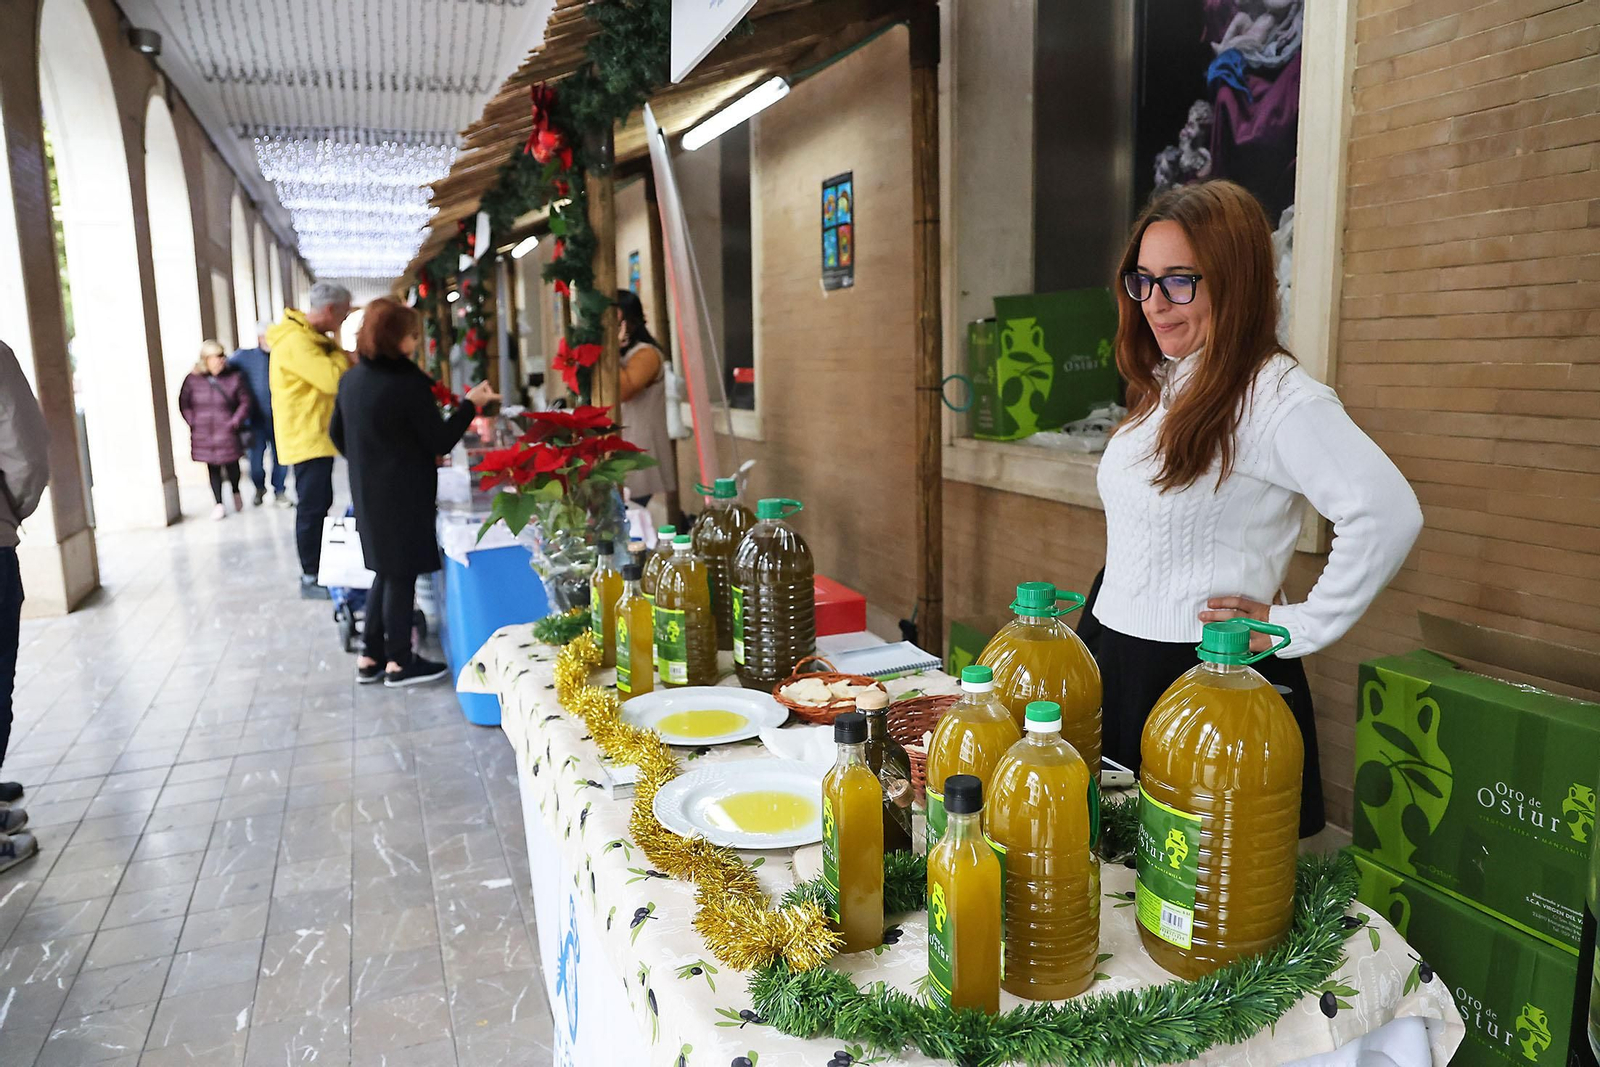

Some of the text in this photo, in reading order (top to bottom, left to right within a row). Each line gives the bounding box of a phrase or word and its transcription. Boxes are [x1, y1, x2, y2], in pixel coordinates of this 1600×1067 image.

[1477, 787, 1560, 833] Ostur
[1495, 781, 1541, 808] Oro de
[1565, 913, 1576, 922] DEL
[1455, 987, 1498, 1020] Oro de
[1460, 1005, 1513, 1047] stur
